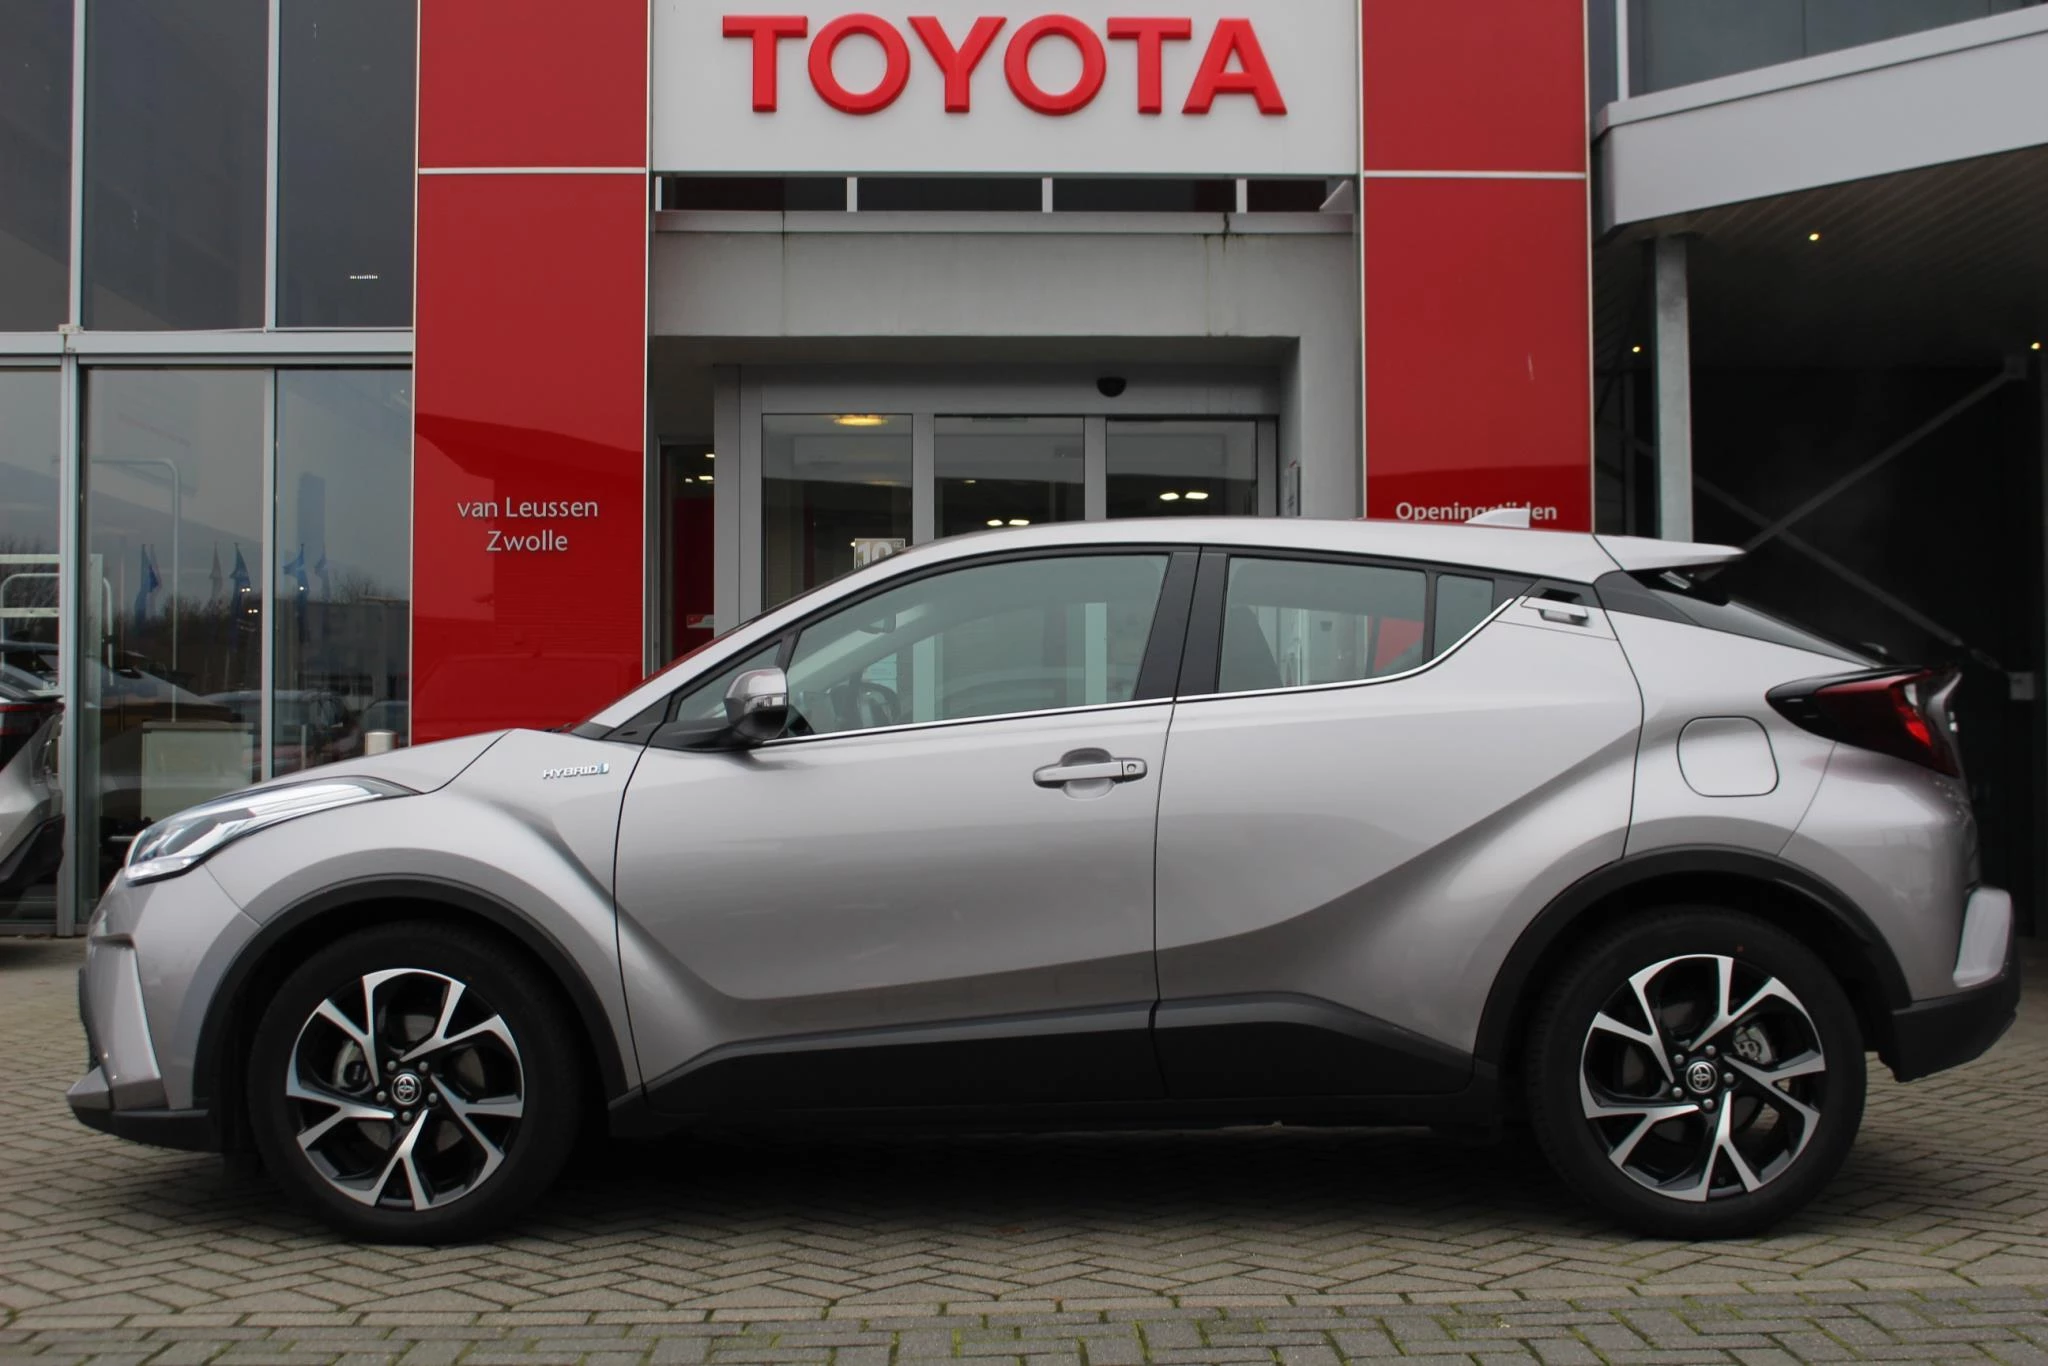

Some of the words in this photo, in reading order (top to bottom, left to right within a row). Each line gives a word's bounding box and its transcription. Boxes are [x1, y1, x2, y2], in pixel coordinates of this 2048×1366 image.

[722, 12, 1288, 116] TOYOTA
[457, 502, 498, 518] van
[506, 496, 598, 518] Leussen
[1396, 501, 1557, 522] Openinen
[486, 529, 568, 551] Zwolle
[543, 764, 598, 779] HYBRID
